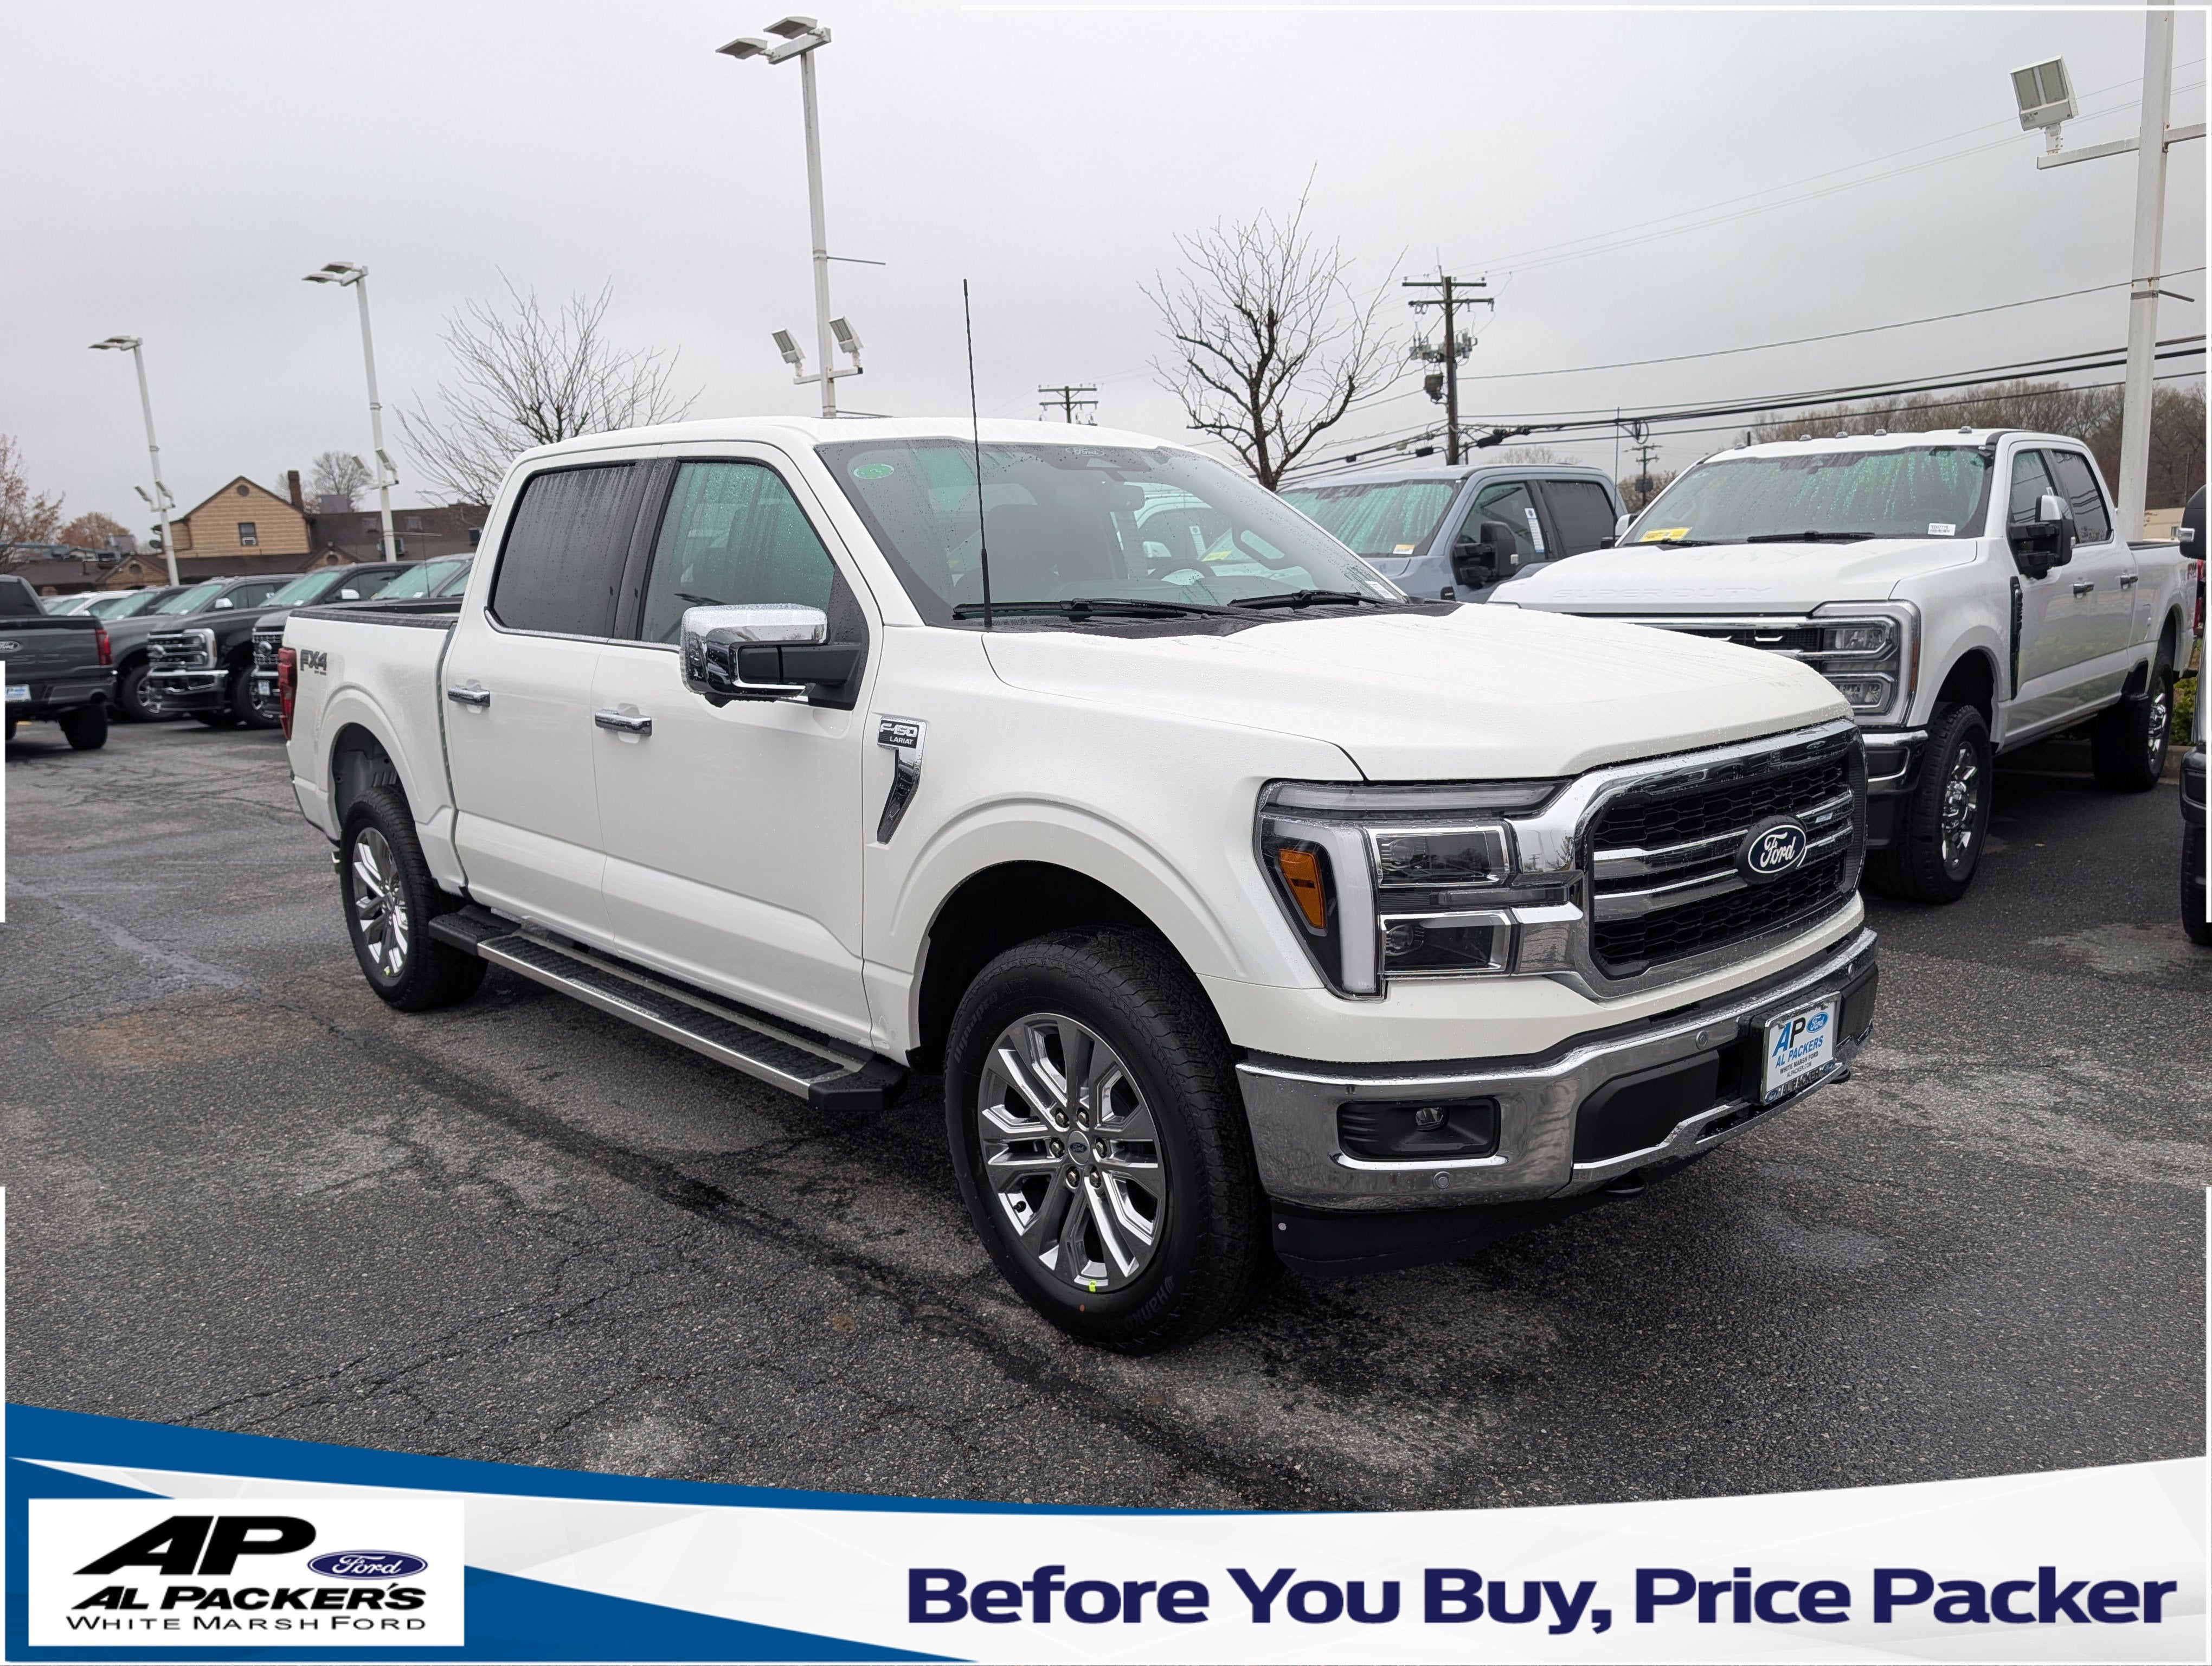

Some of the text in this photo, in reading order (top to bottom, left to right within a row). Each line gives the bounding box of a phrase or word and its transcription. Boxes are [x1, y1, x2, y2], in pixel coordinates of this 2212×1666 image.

[1553, 587, 1772, 599] SUPER DUTY
[300, 649, 327, 671] FX4
[880, 722, 918, 738] F-150
[890, 735, 914, 745] LARIAT
[1760, 832, 1796, 868] Ford
[1772, 1017, 1806, 1058] AP
[1775, 1035, 1823, 1069] AL PACKERS
[1780, 1050, 1819, 1074] WHITE MARSH FORD
